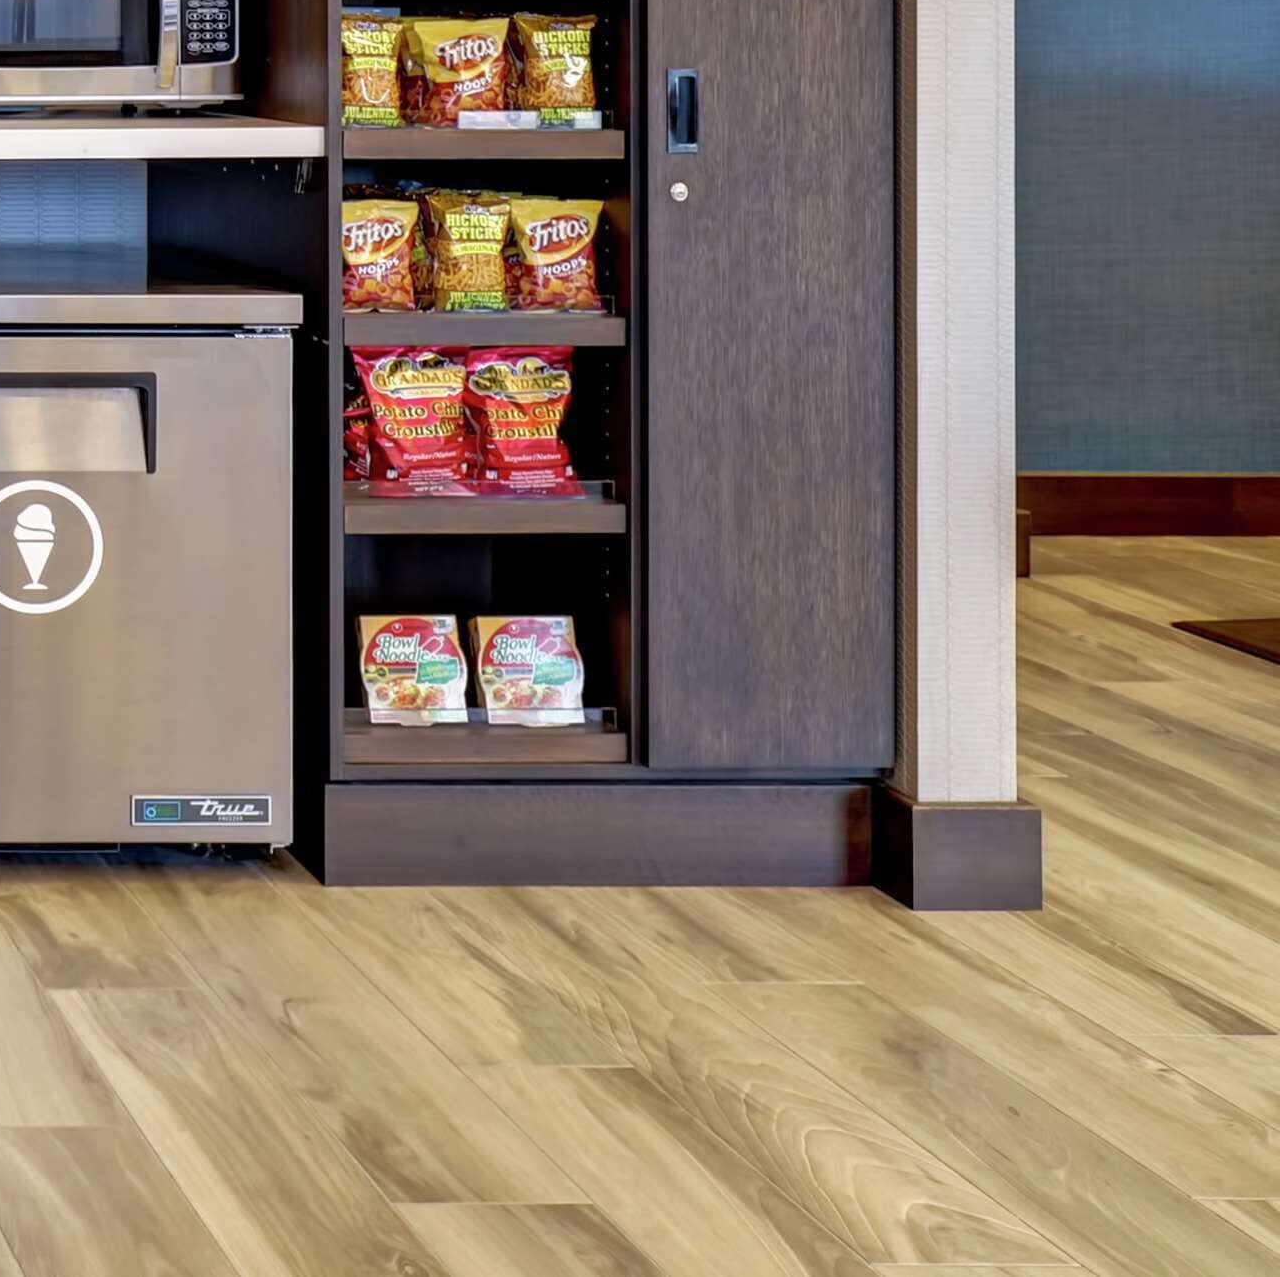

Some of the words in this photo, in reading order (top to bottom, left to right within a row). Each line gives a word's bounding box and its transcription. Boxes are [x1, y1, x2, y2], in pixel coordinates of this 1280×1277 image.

[532, 29, 591, 43] HICKORY
[434, 34, 497, 69] Fritos
[539, 42, 590, 56] STICKS
[342, 218, 403, 251] Fritos
[525, 217, 589, 252] Fritos
[358, 256, 400, 276] HOOPS
[543, 255, 587, 276] HOOPS
[372, 403, 427, 419] Potato
[486, 406, 528, 420] otato
[376, 633, 420, 650] Bowl
[494, 634, 536, 651] Bowl
[373, 647, 429, 663] Noodle
